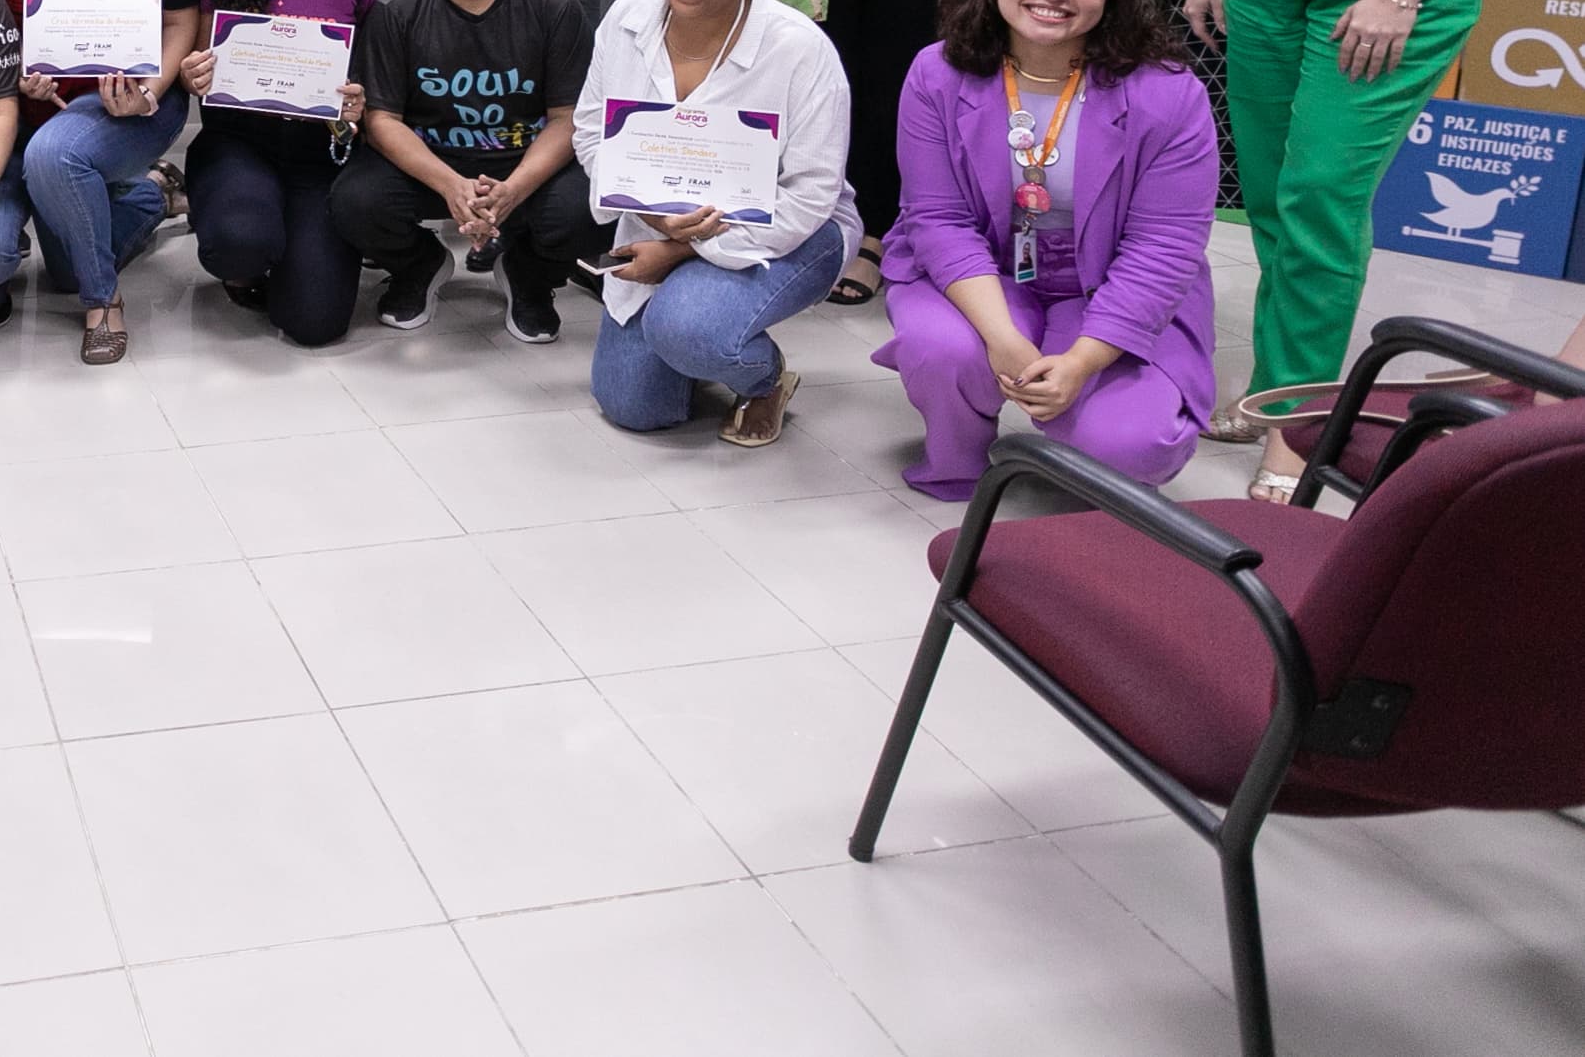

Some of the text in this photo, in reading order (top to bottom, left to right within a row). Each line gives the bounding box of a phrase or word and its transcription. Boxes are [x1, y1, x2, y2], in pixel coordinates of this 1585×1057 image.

[270, 24, 297, 34] Aurora
[417, 67, 535, 97] SOUL
[454, 103, 504, 126] DO
[674, 111, 708, 123] Aurora
[1443, 114, 1568, 146] PAZ, JUSTIÇA E
[1440, 133, 1555, 162] INSTITUIÇÕES
[1437, 153, 1513, 176] EFICAZES
